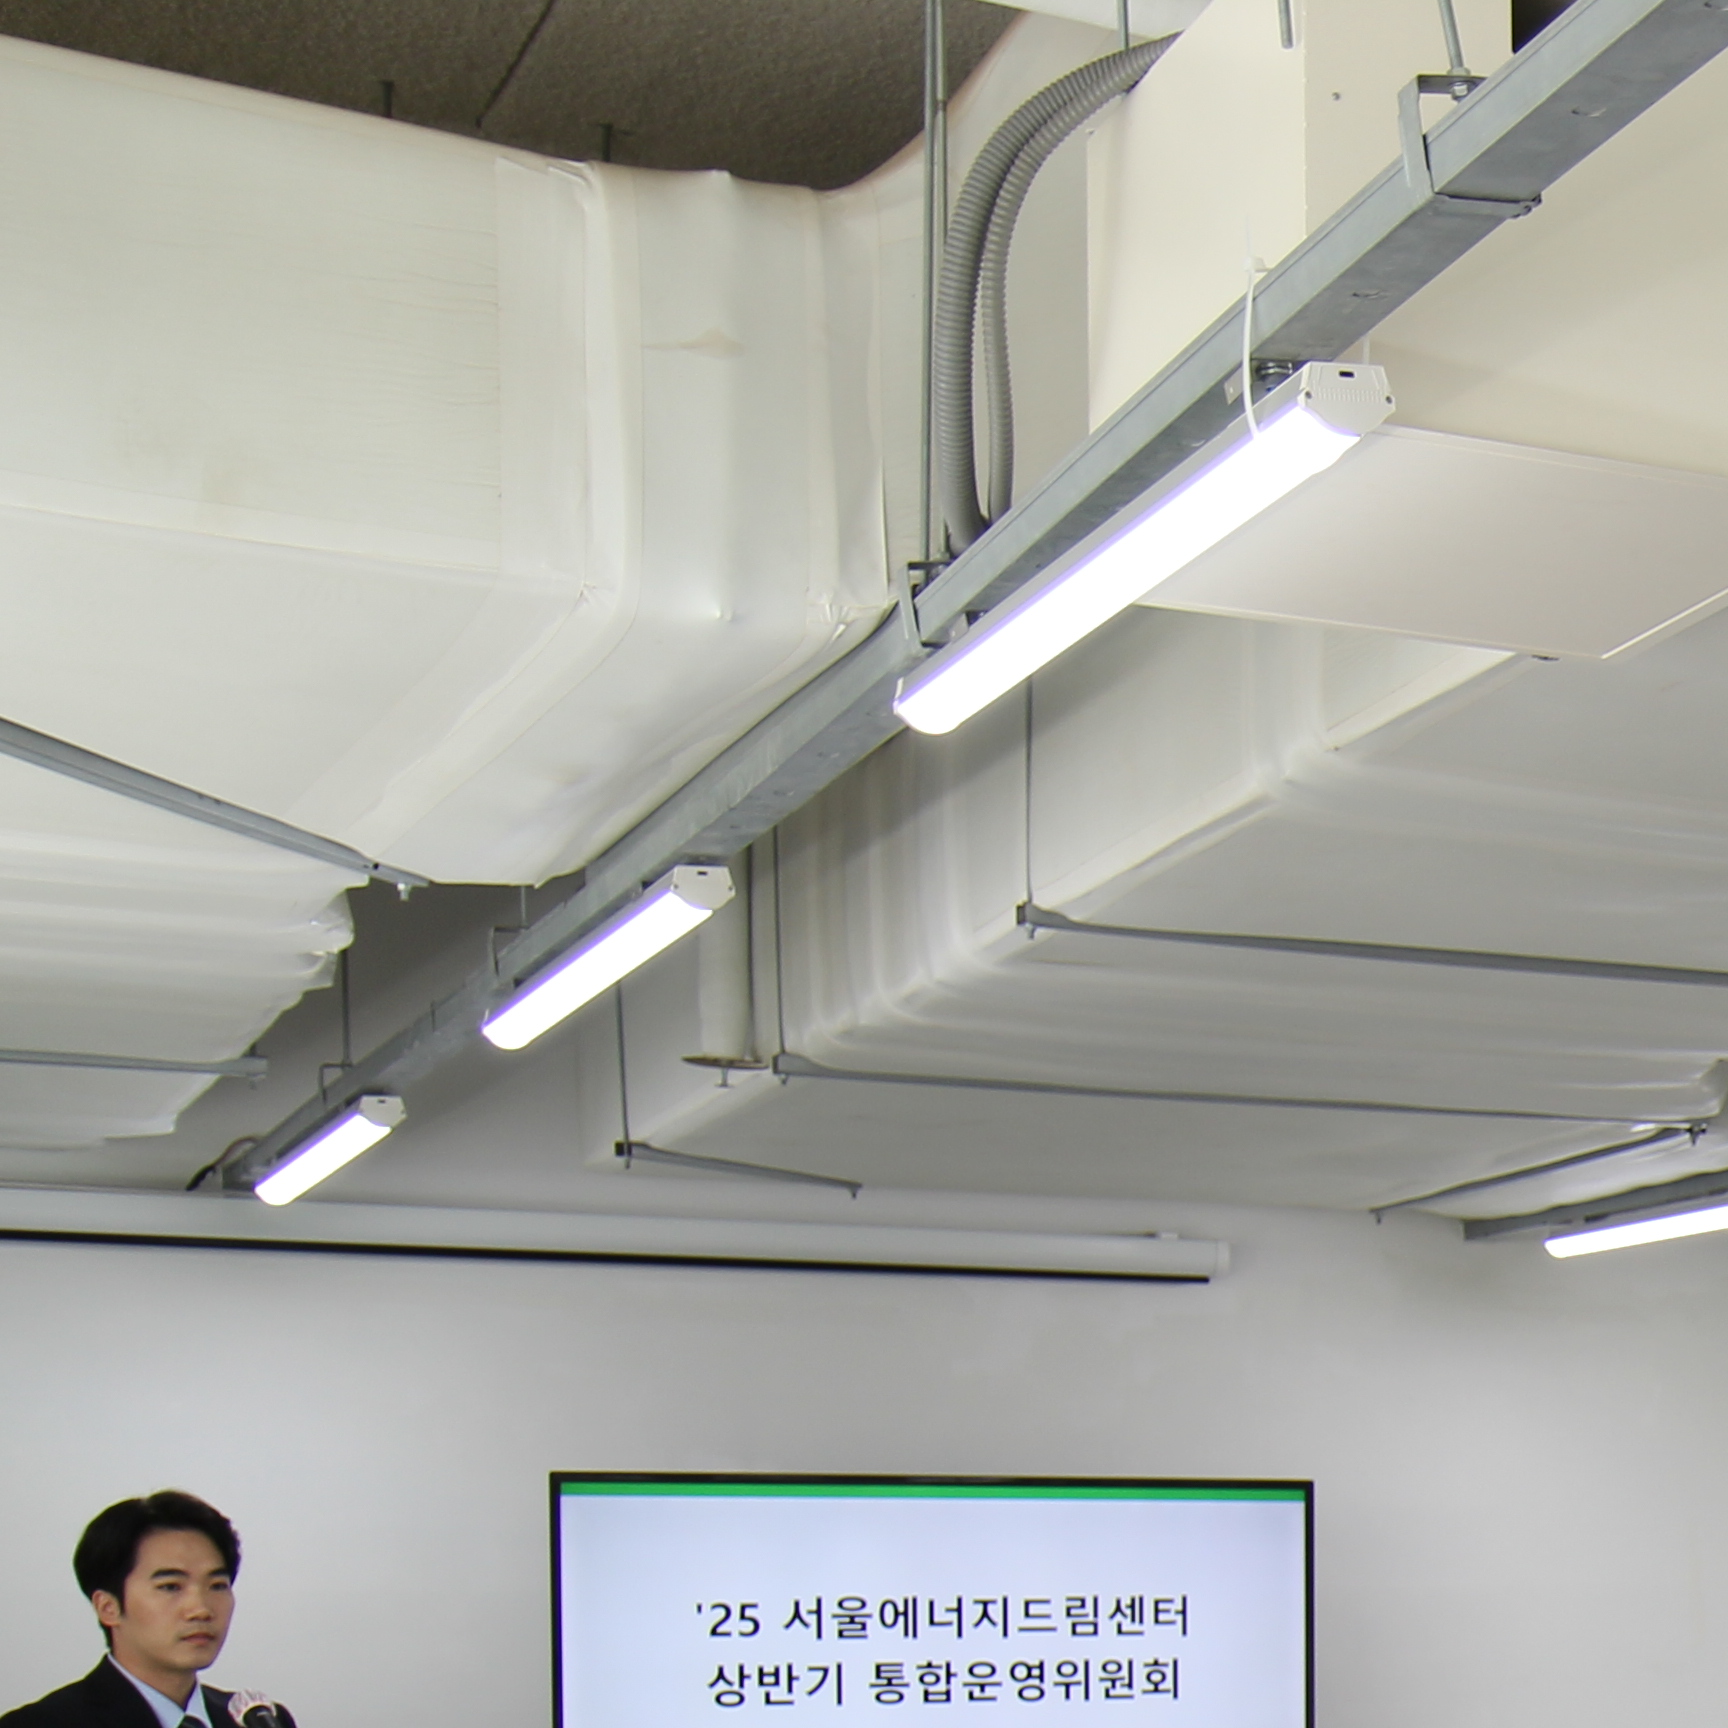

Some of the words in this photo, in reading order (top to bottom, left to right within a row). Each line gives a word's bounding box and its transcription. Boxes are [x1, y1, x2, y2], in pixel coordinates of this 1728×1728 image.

[695, 1601, 761, 1637] '25
[783, 1593, 1190, 1640] 서울에너지드림센터
[706, 1662, 847, 1707] 상반기
[868, 1656, 1182, 1704] 통합운영위원회
